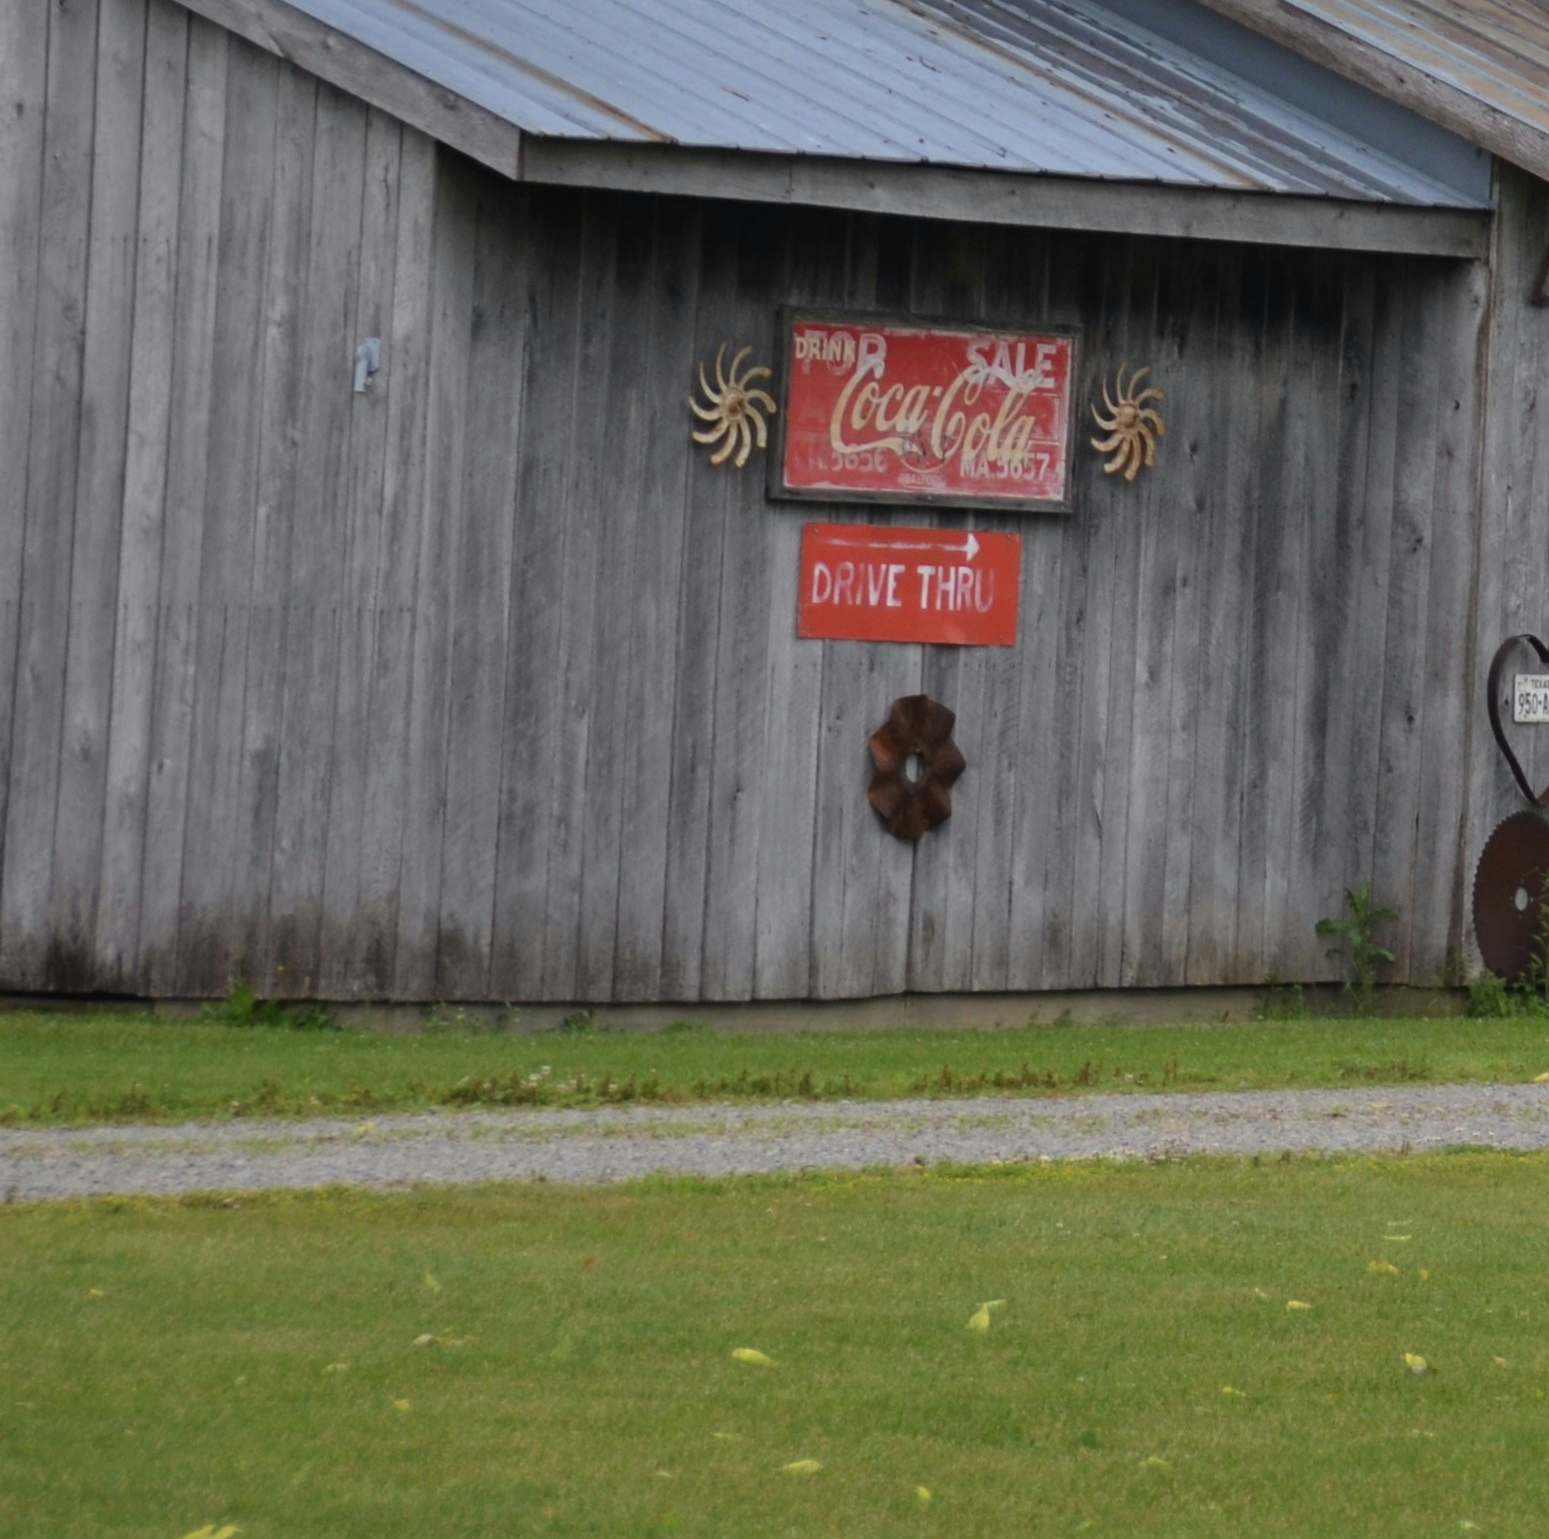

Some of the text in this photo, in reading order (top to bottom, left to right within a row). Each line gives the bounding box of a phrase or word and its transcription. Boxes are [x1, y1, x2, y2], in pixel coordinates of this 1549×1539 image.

[966, 341, 1057, 389] SALE
[830, 355, 1044, 463] Coca-Cola
[811, 561, 995, 613] DRIVE THRU
